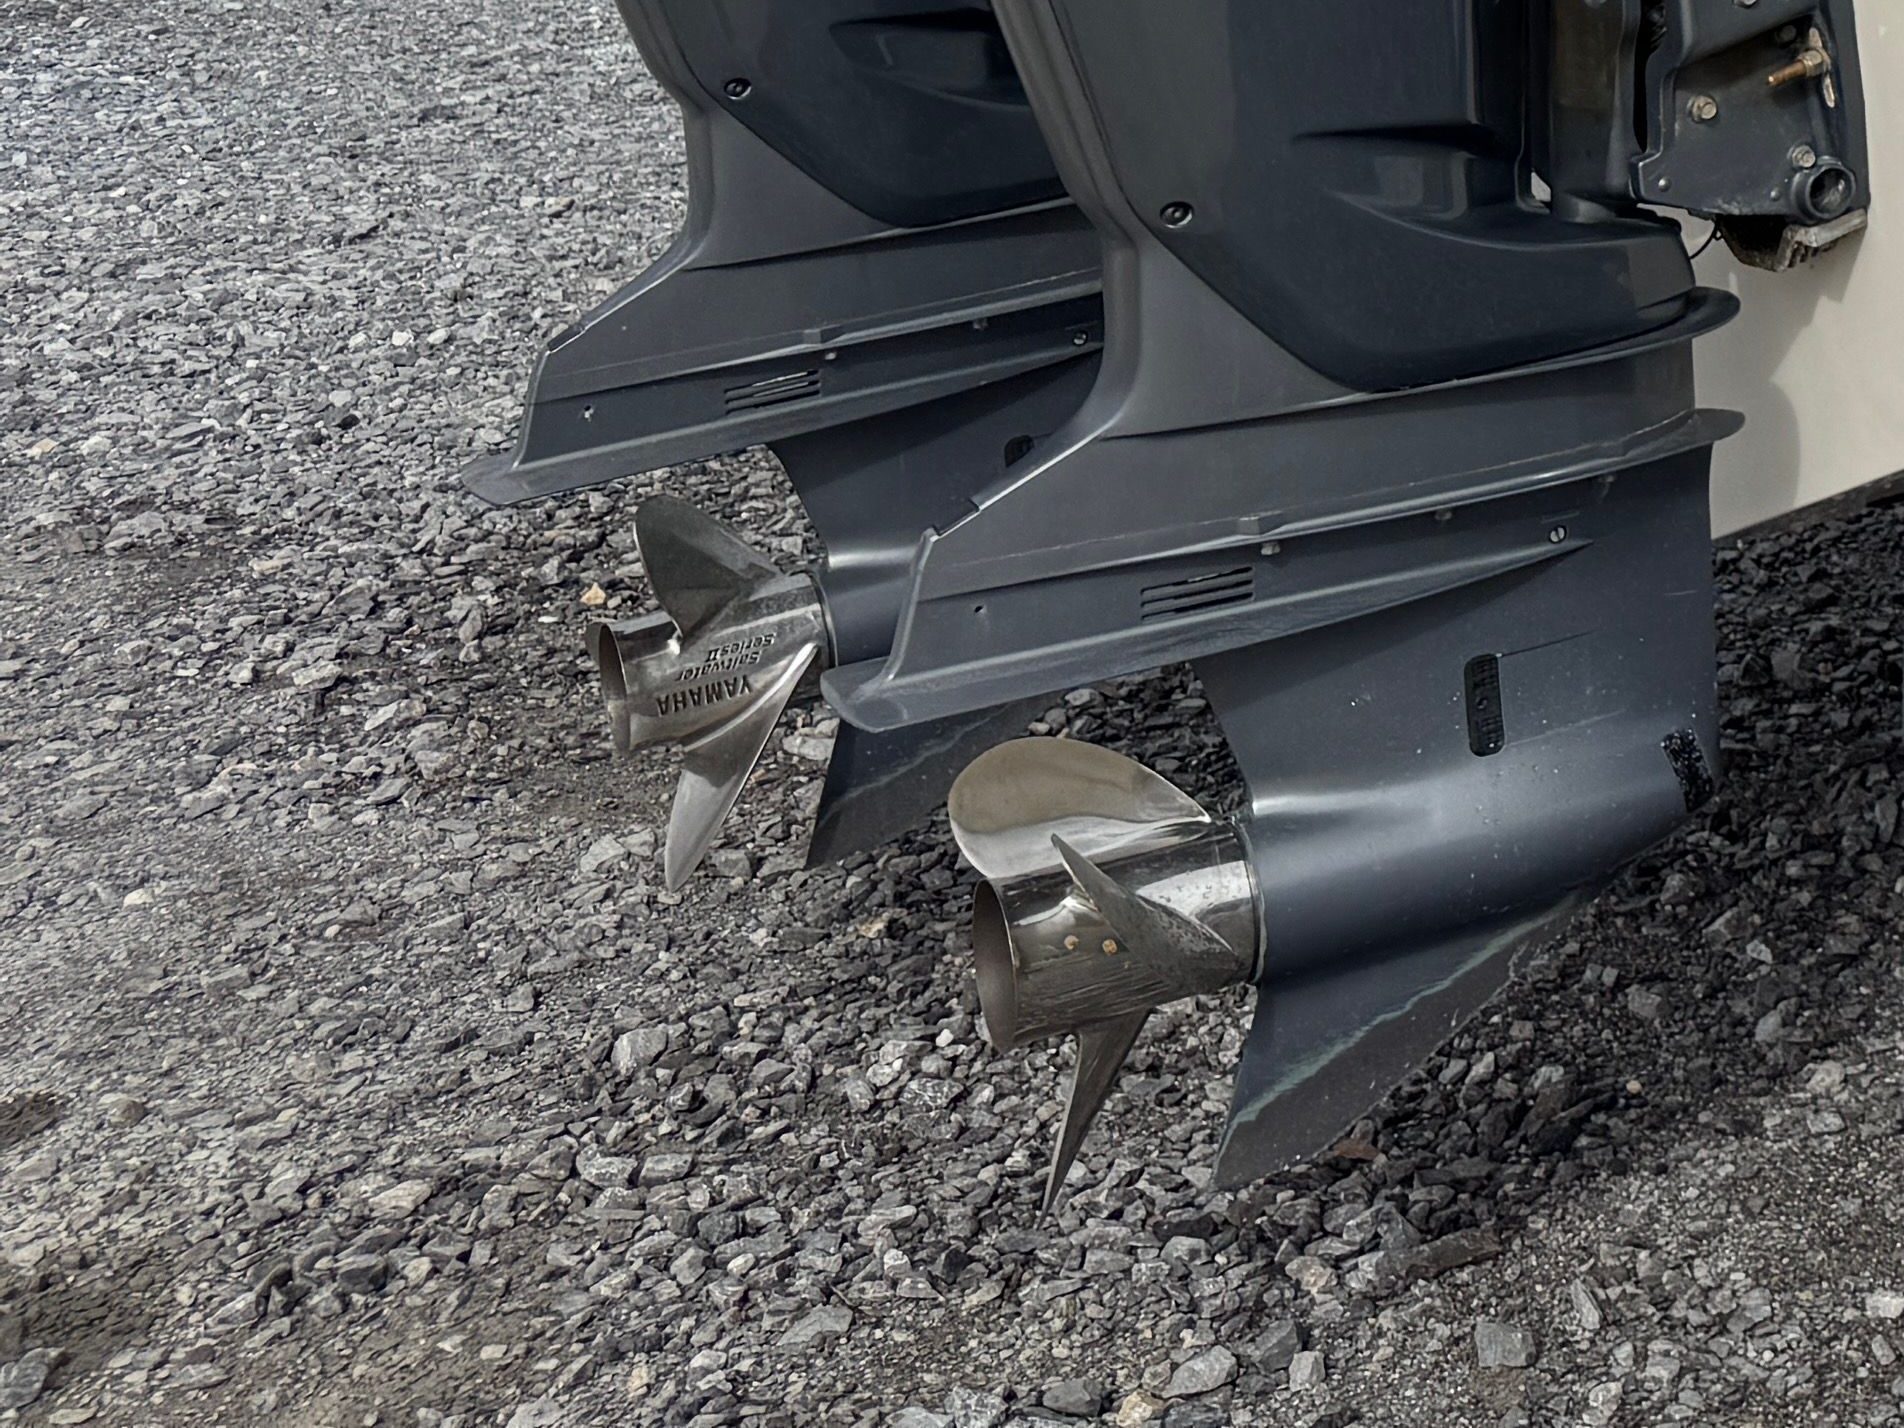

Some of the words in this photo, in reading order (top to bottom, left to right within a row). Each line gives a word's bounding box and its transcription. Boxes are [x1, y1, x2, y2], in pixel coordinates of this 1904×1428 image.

[719, 631, 777, 654] Series
[675, 650, 761, 681] Saltwater
[656, 674, 752, 717] YAMAHA
